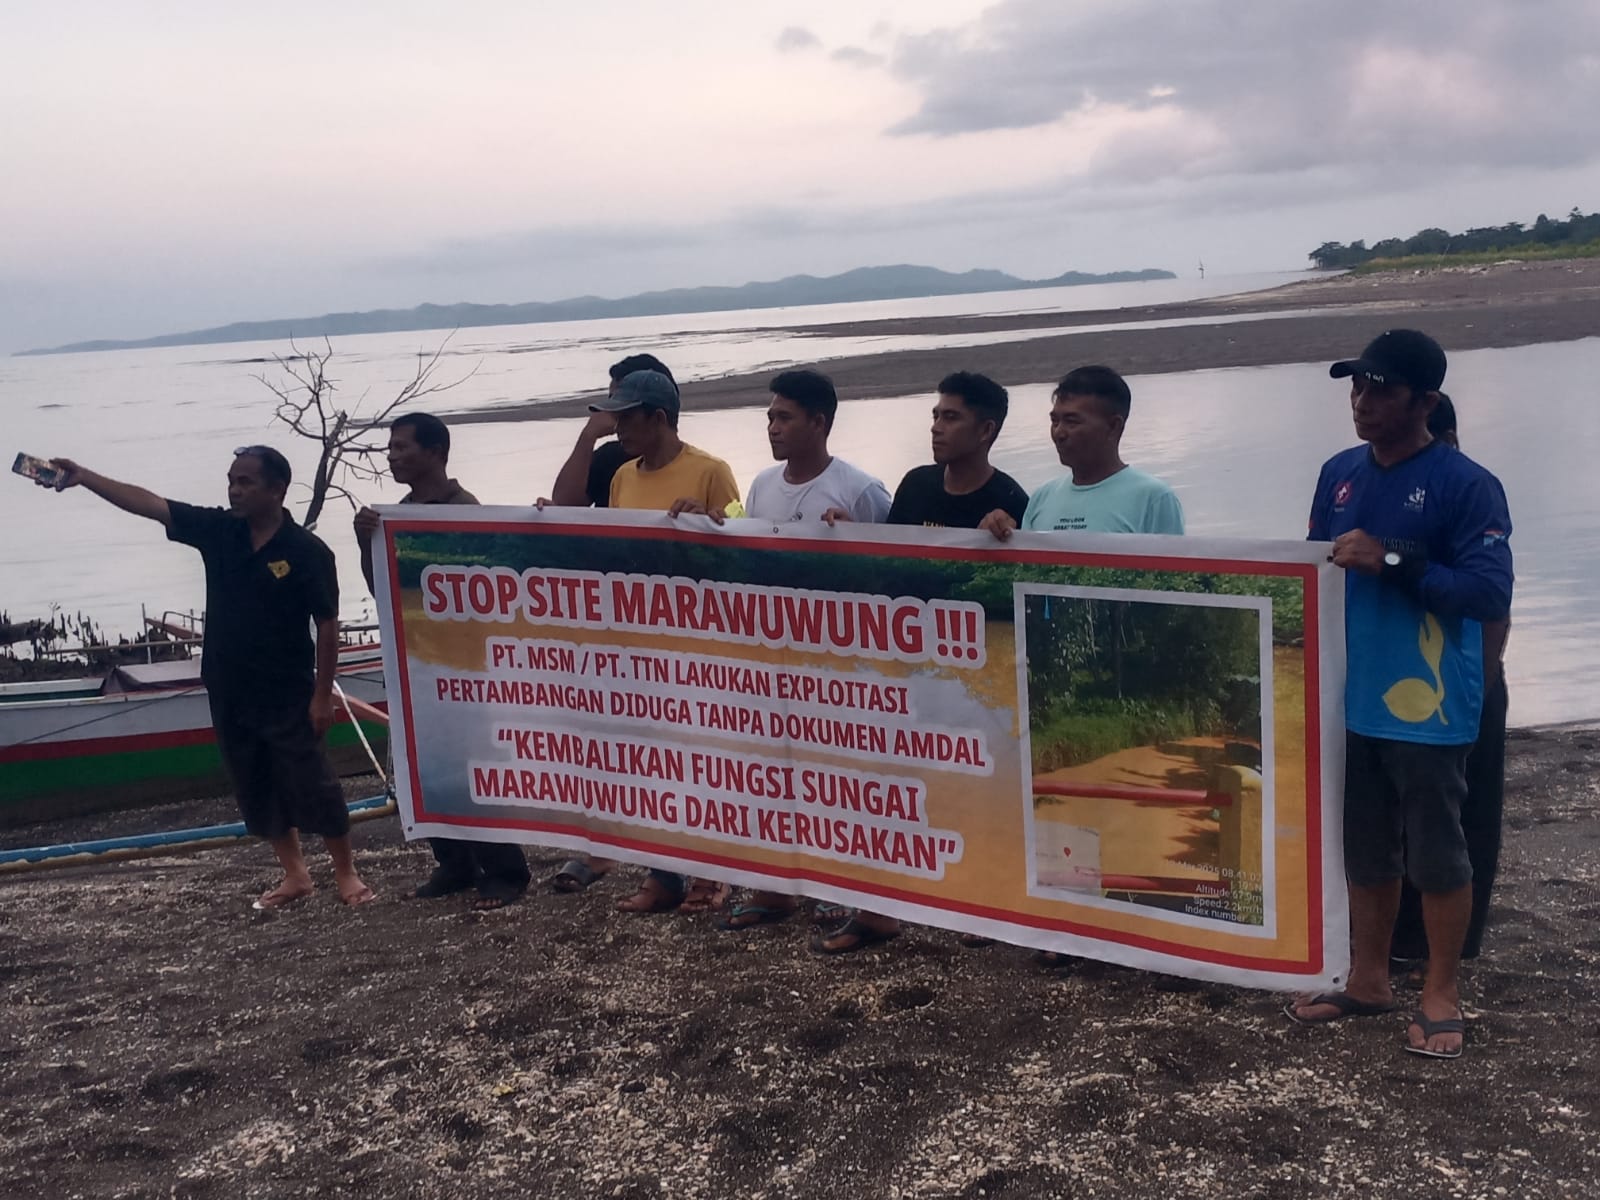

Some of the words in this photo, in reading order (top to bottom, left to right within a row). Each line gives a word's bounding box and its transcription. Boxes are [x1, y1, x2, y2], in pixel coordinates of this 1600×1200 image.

[427, 572, 518, 615] STOP
[527, 576, 602, 622] SITE
[612, 581, 923, 654] MARAWUWUNG
[935, 608, 979, 660] !!!
[492, 644, 522, 669] PT.
[528, 646, 575, 674] MSM
[595, 653, 626, 679] PT.
[630, 655, 669, 684] TTN
[676, 660, 770, 698] LAKUKAN
[776, 673, 909, 715] EXPLOITASI
[437, 678, 604, 715] PERTAMBANGAN
[610, 691, 692, 726] DIDUGA
[697, 701, 764, 736] TANPA
[770, 712, 886, 754] DOKUMEN
[893, 729, 986, 767] AMDAL
[474, 767, 678, 824] MARAWUWUNG
[685, 795, 751, 838] DARI
[692, 752, 796, 801] FUNGSI
[802, 770, 920, 823] SUNGAI
[1185, 904, 1209, 916] Index
